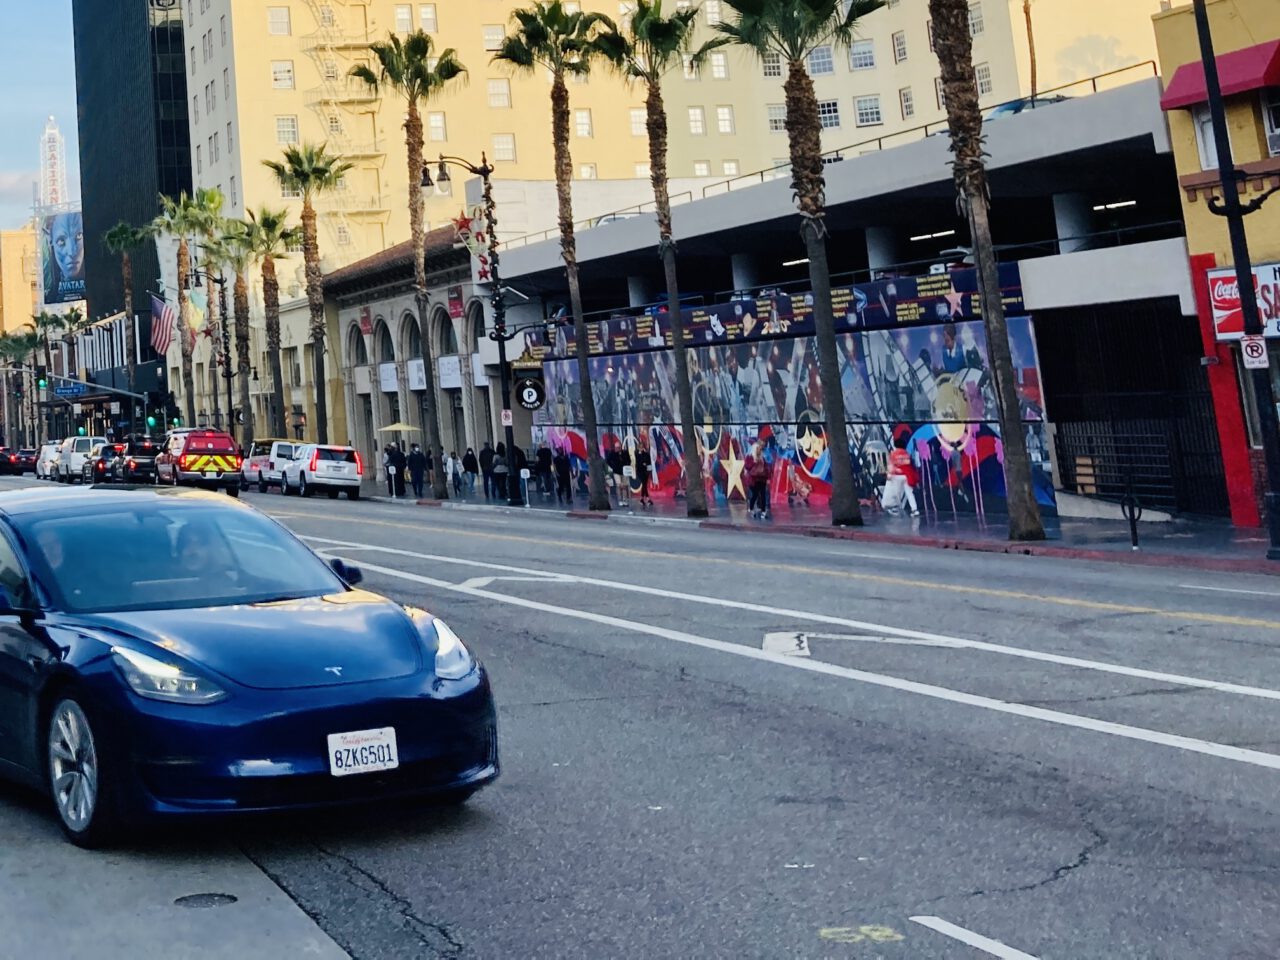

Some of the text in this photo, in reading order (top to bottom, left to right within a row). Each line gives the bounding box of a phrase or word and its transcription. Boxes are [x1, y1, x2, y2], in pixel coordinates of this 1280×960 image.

[58, 280, 86, 291] AVATAR
[527, 390, 534, 400] P
[334, 743, 394, 769] 8ZKG501
